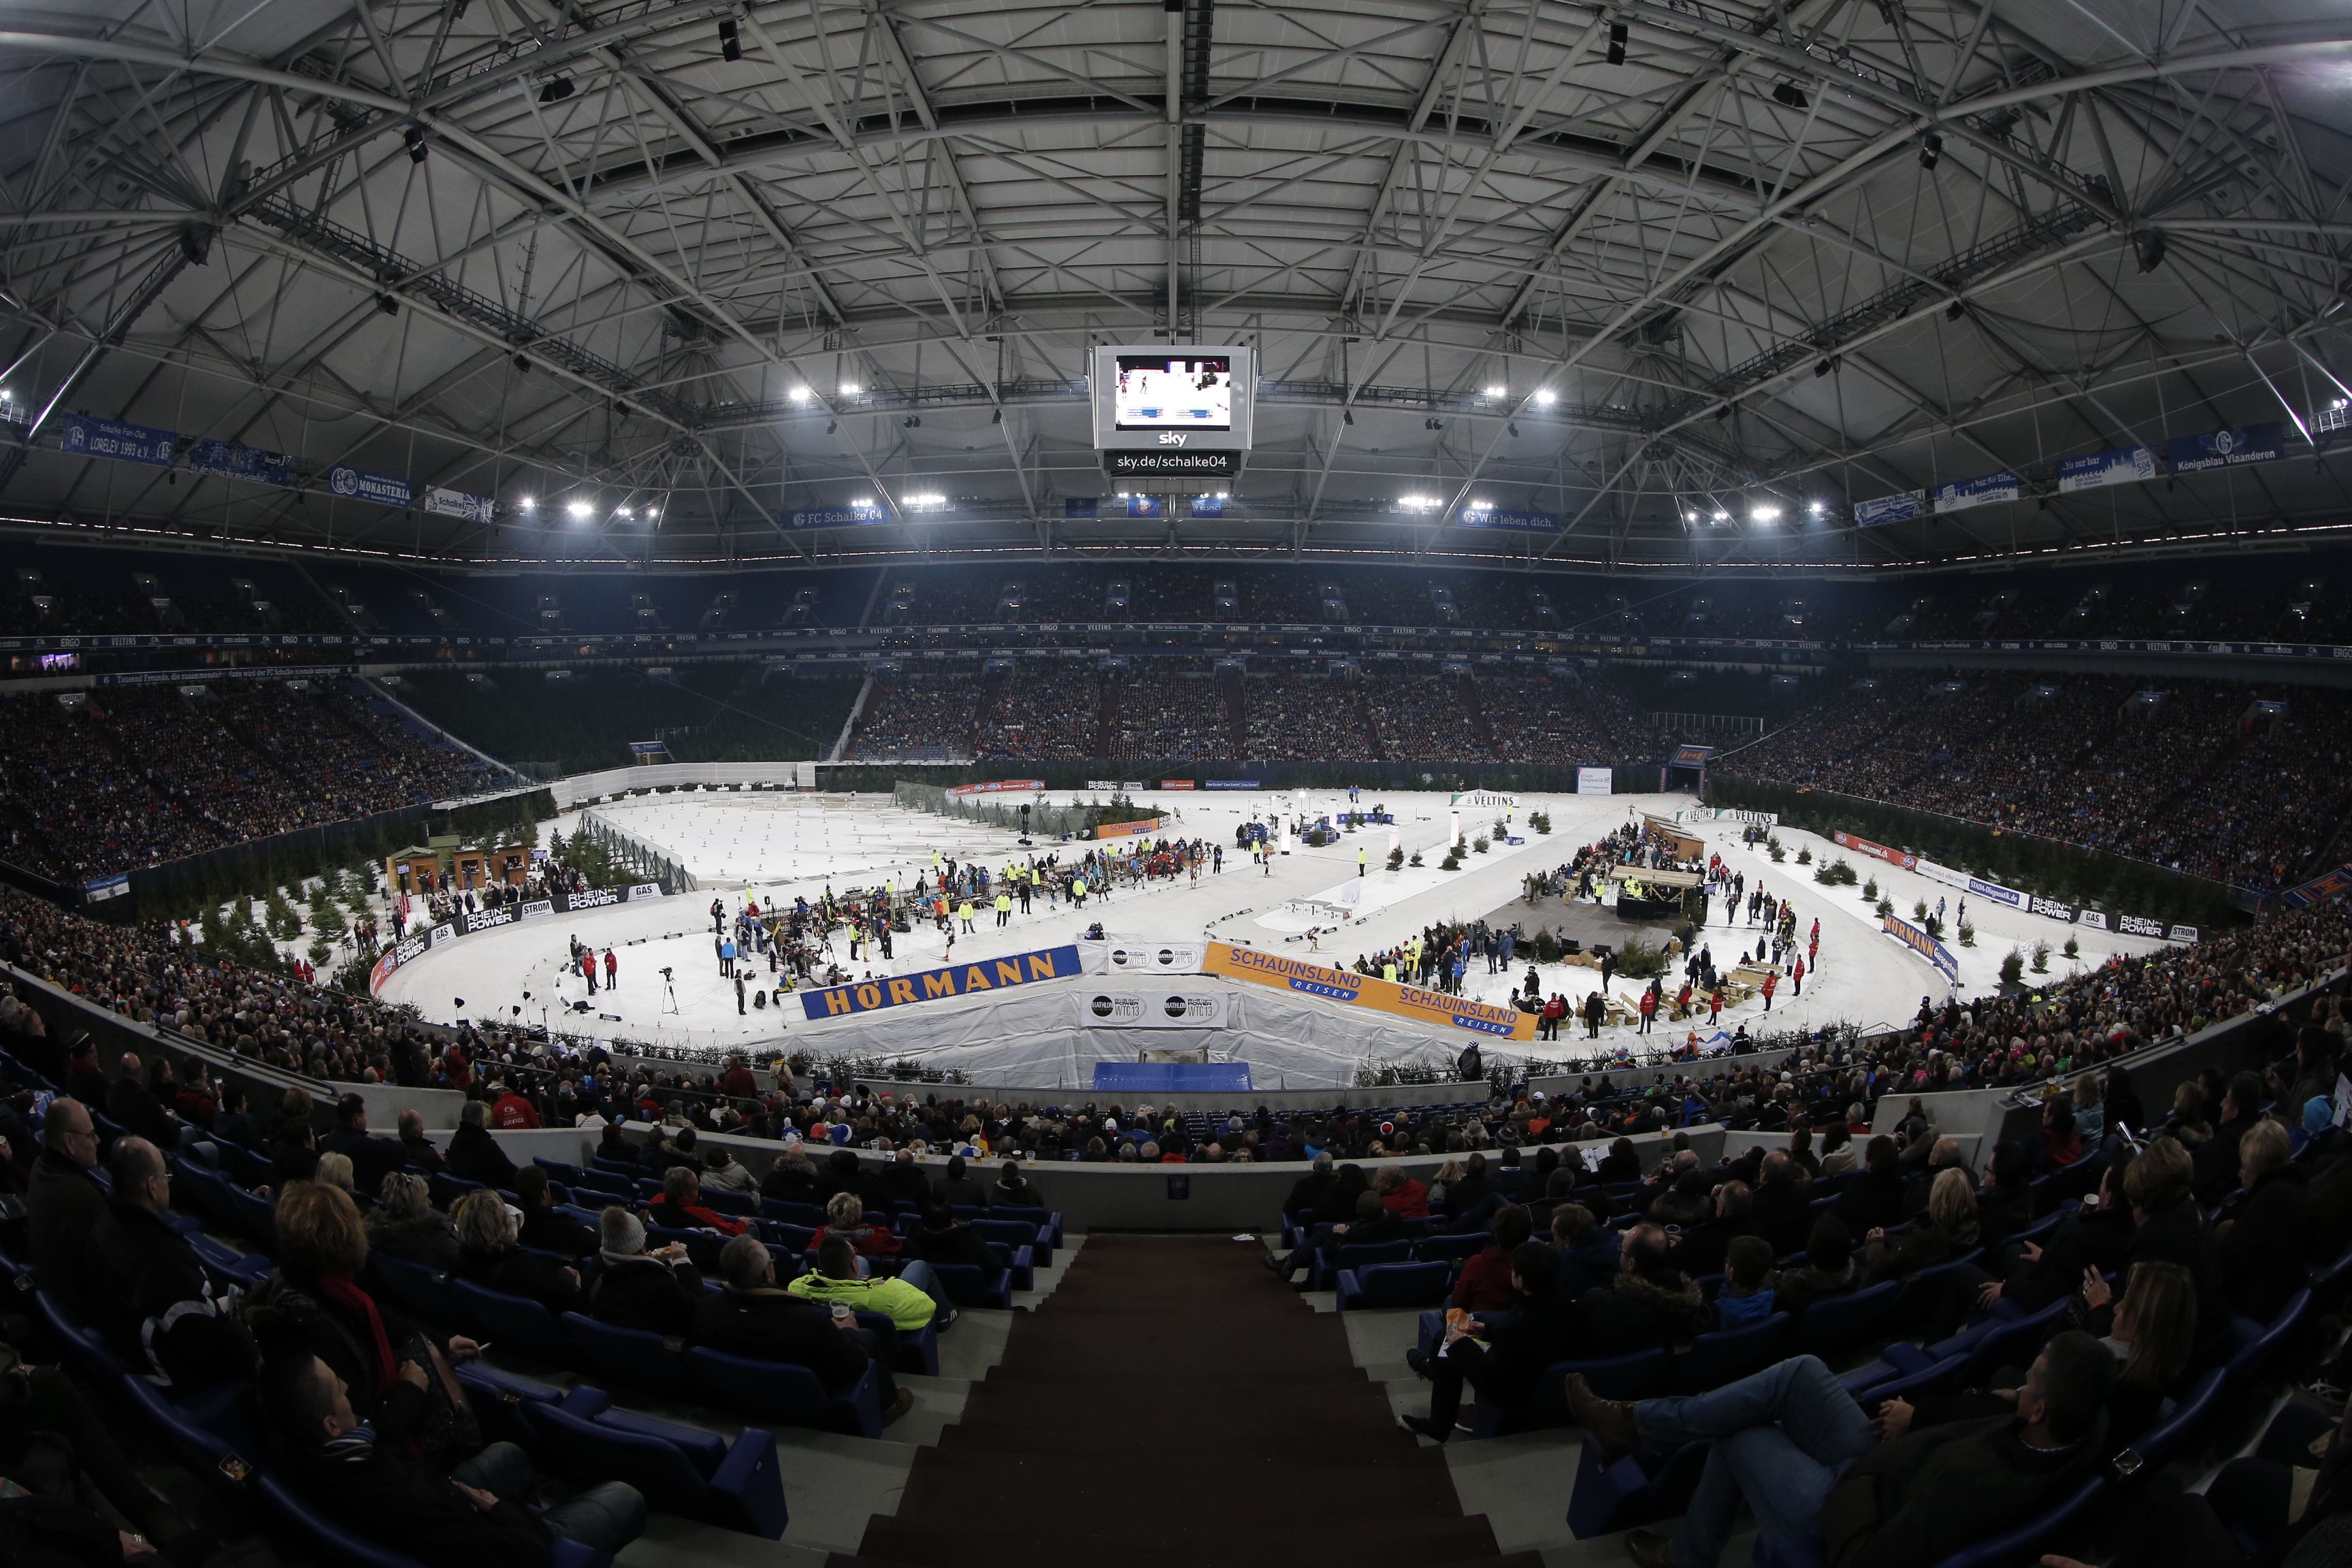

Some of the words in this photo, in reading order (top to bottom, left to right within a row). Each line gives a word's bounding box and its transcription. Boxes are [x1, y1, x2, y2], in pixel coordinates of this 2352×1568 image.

[100, 424, 121, 435] Schalke
[122, 428, 146, 438] Fan-Club
[1158, 431, 1188, 448] sky
[90, 437, 119, 453] LORELEY
[120, 443, 136, 456] 1993
[137, 446, 150, 459] e.V.
[1117, 455, 1228, 470] sky.de/schalke04
[2087, 457, 2100, 466] Isar
[2178, 456, 2223, 471] Königsblau
[2225, 450, 2276, 463] Vlaanderen
[359, 479, 410, 500] MONASTERIA
[439, 497, 462, 509] Schalke
[808, 514, 821, 523] FC
[824, 512, 866, 522] Schalke
[870, 510, 883, 520] 04
[1479, 513, 1497, 523] Wir
[1501, 514, 1526, 525] leben
[1531, 517, 1554, 527] dich.
[61, 638, 80, 647] ERGO
[112, 637, 136, 646] VELTINS
[323, 636, 342, 644] VELTINS
[2147, 642, 2170, 651] VELTINS
[118, 675, 143, 683] Tausend
[144, 673, 169, 683] Freunde,
[172, 672, 180, 681] die
[315, 666, 340, 675] untergehn!
[1475, 796, 1514, 806] VELTINS
[1690, 808, 1712, 819] VELTINS
[1735, 811, 1772, 823] VELTINS
[1858, 842, 1888, 859] www.emmi.ch
[1918, 863, 1934, 873] Gesundheit
[1955, 876, 1965, 885] testen!
[568, 888, 608, 902] RHEIN
[636, 885, 653, 895] GAS
[1970, 881, 2017, 903] STADA-Diagnostik.de
[524, 903, 550, 914] STROM
[569, 894, 618, 910] POWER
[1292, 904, 1296, 913] 2
[2033, 897, 2064, 911] RHEIN
[467, 906, 503, 924] RHEIN
[1311, 905, 1315, 915] 1
[2031, 905, 2071, 919] POWER
[468, 913, 513, 932] POWER
[2086, 913, 2100, 923] GAS
[2121, 915, 2155, 927] RHEIN
[436, 927, 448, 939] GAS
[2119, 922, 2161, 936] POWER
[2173, 927, 2195, 937] STROM
[1884, 915, 1935, 958] HÖRMANN
[397, 935, 419, 956] RHEIN
[397, 941, 425, 966] POWER
[1187, 956, 1193, 964] 13
[1129, 957, 1140, 965] WTC
[1230, 948, 1362, 989] SCHAUINSLAND
[823, 953, 1056, 1015] HÖRMANN
[1294, 980, 1351, 1000] REISEN
[1115, 1006, 1130, 1015] WTC
[1132, 1006, 1139, 1016] 13
[1188, 1007, 1203, 1016] WTC
[1205, 1007, 1212, 1016] 13
[1399, 987, 1518, 1024] SCHAUINSLAND
[1457, 1016, 1508, 1035] REISEN
[504, 1117, 524, 1126] SERVICE
